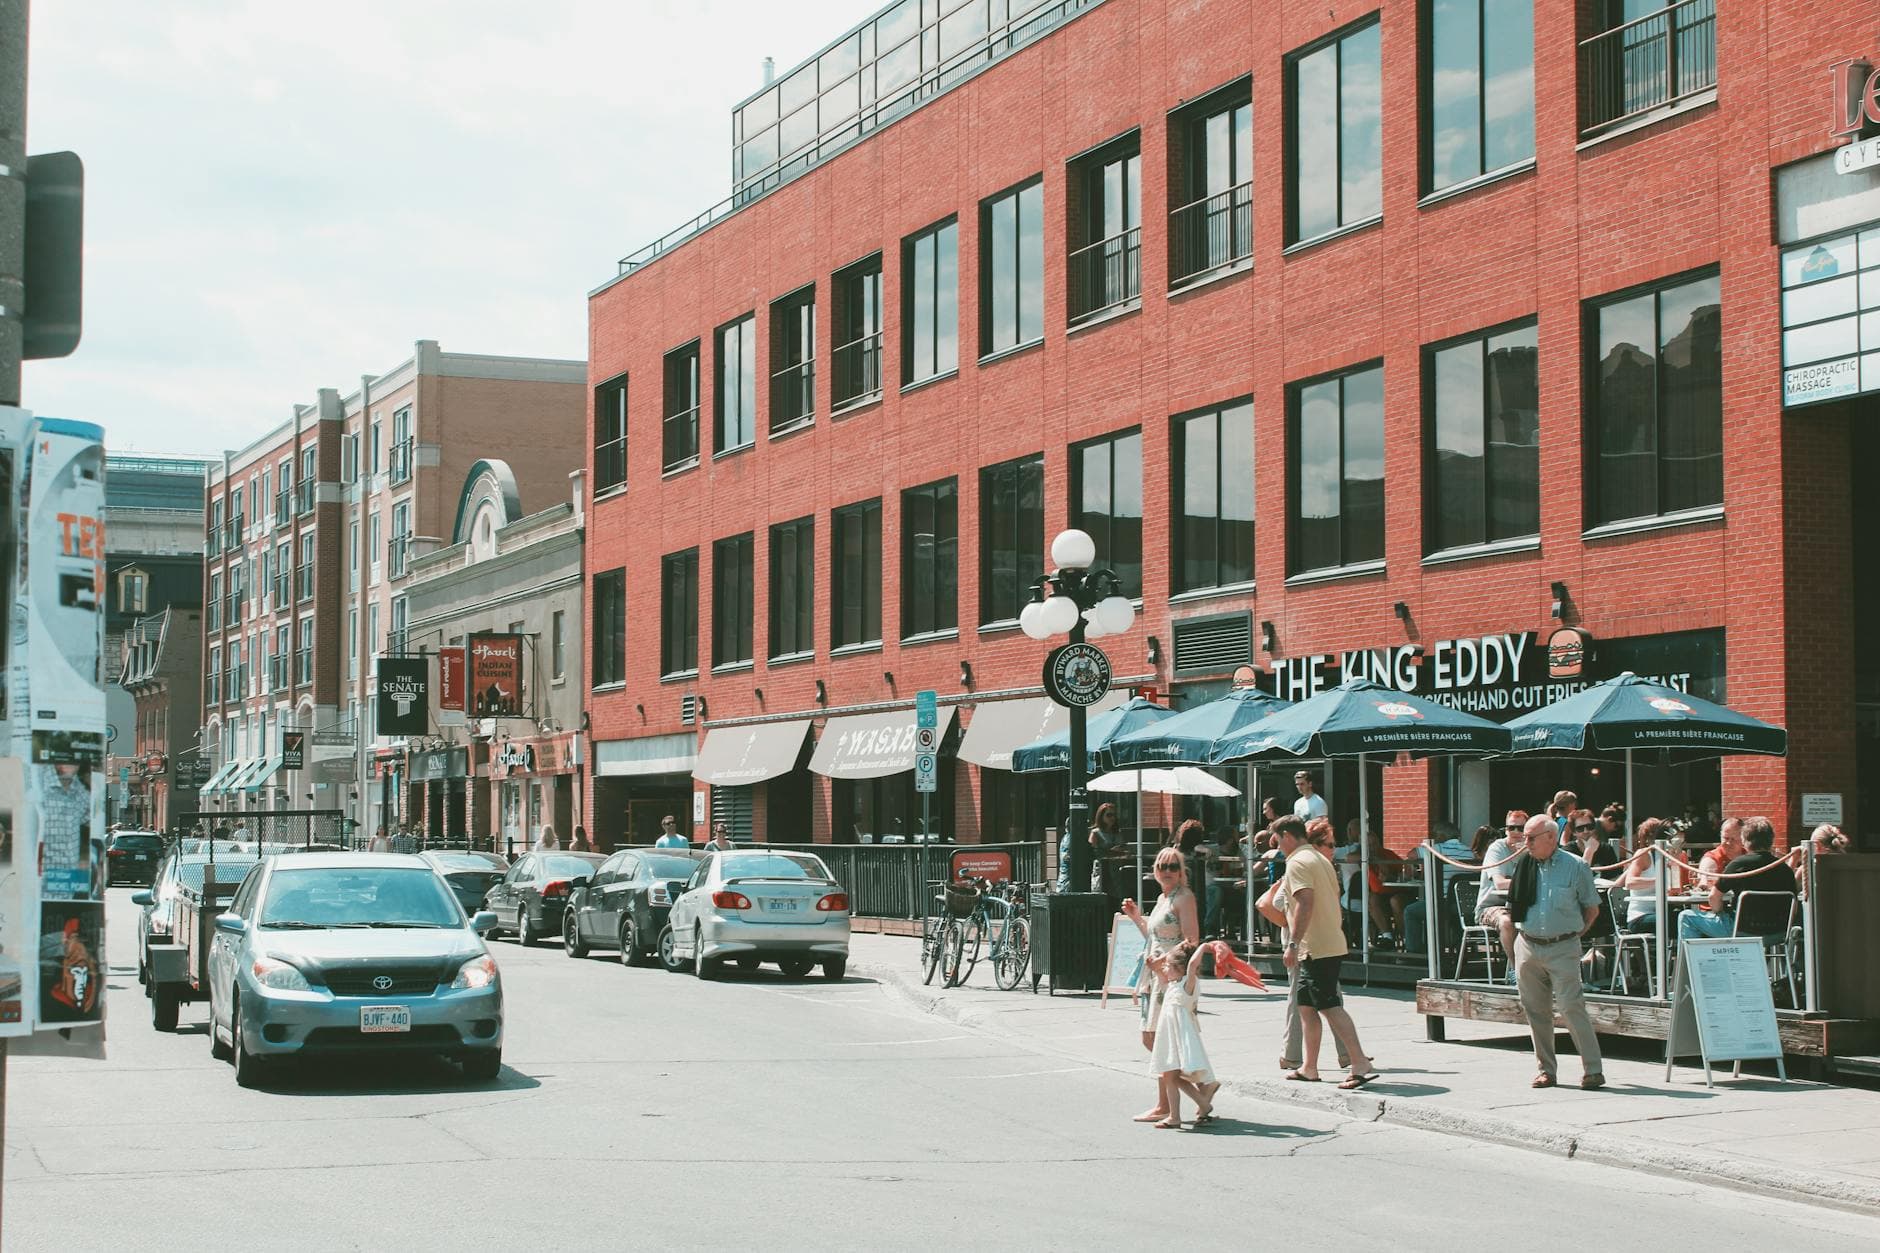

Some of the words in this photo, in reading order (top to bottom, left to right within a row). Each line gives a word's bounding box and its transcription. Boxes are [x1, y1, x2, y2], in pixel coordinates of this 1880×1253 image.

[1787, 360, 1857, 384] CHIROPRACTIC
[1787, 377, 1832, 395] MASSAGE
[478, 661, 512, 669] INDIAN
[1056, 647, 1080, 675] BYWARD
[1082, 647, 1108, 675] MARKET
[1270, 654, 1326, 702] THE
[1341, 643, 1418, 692] KING
[1434, 631, 1528, 689] EDDY
[395, 675, 413, 683] THE
[477, 670, 512, 678] CUISINE
[382, 682, 425, 693] SENATE
[1095, 687, 1103, 698] BY
[1467, 688, 1509, 711] HAND
[1511, 685, 1543, 709] CUT
[846, 724, 917, 756] WASAB
[1363, 735, 1373, 743] LA
[1634, 731, 1644, 739] LA
[923, 759, 929, 769] P
[1712, 947, 1740, 955] EMPIRE
